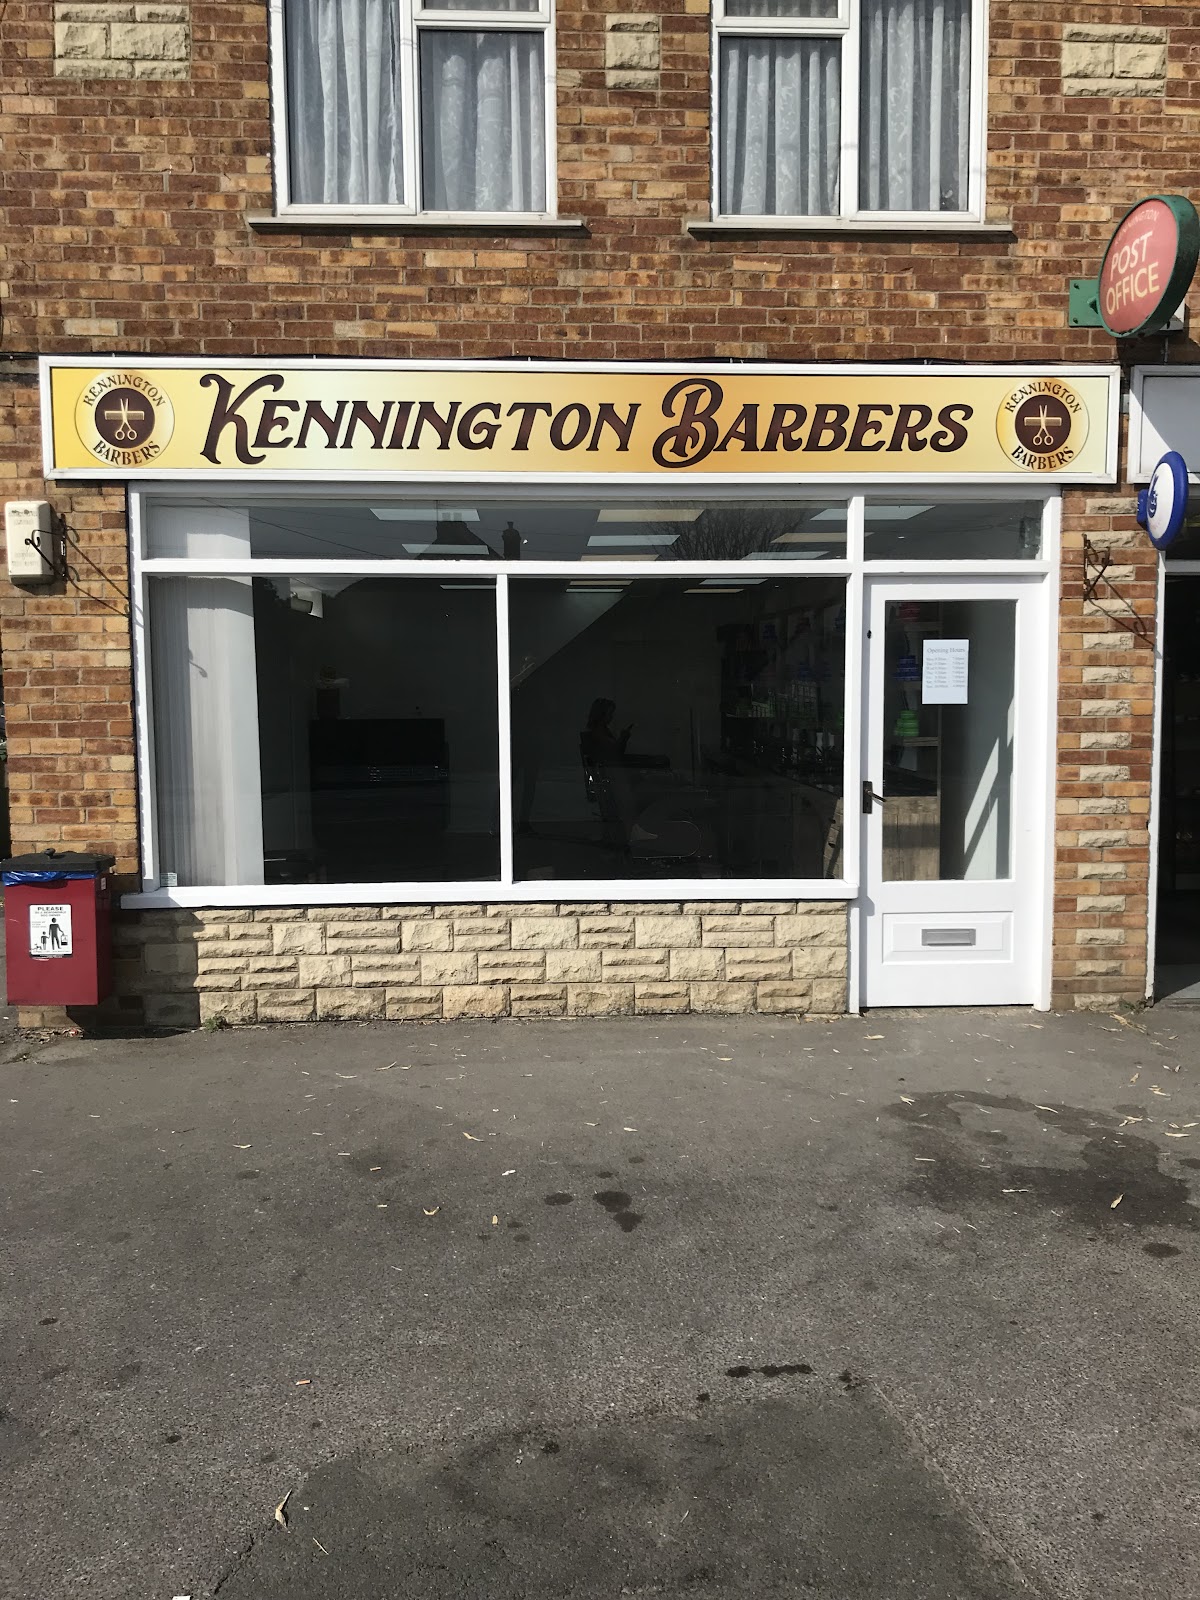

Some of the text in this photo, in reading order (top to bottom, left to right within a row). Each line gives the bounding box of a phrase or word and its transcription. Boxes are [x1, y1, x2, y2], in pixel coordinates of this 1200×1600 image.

[1114, 208, 1160, 246] NINGTON
[1110, 230, 1153, 281] POST
[1105, 262, 1160, 315] OFFICE
[83, 374, 166, 407] KENNINGTON
[1004, 381, 1082, 414] KENNINGTON
[199, 373, 974, 468] KENNINGTON BARBERS
[93, 440, 161, 465] BARBERS
[1011, 445, 1075, 470] BARBERS
